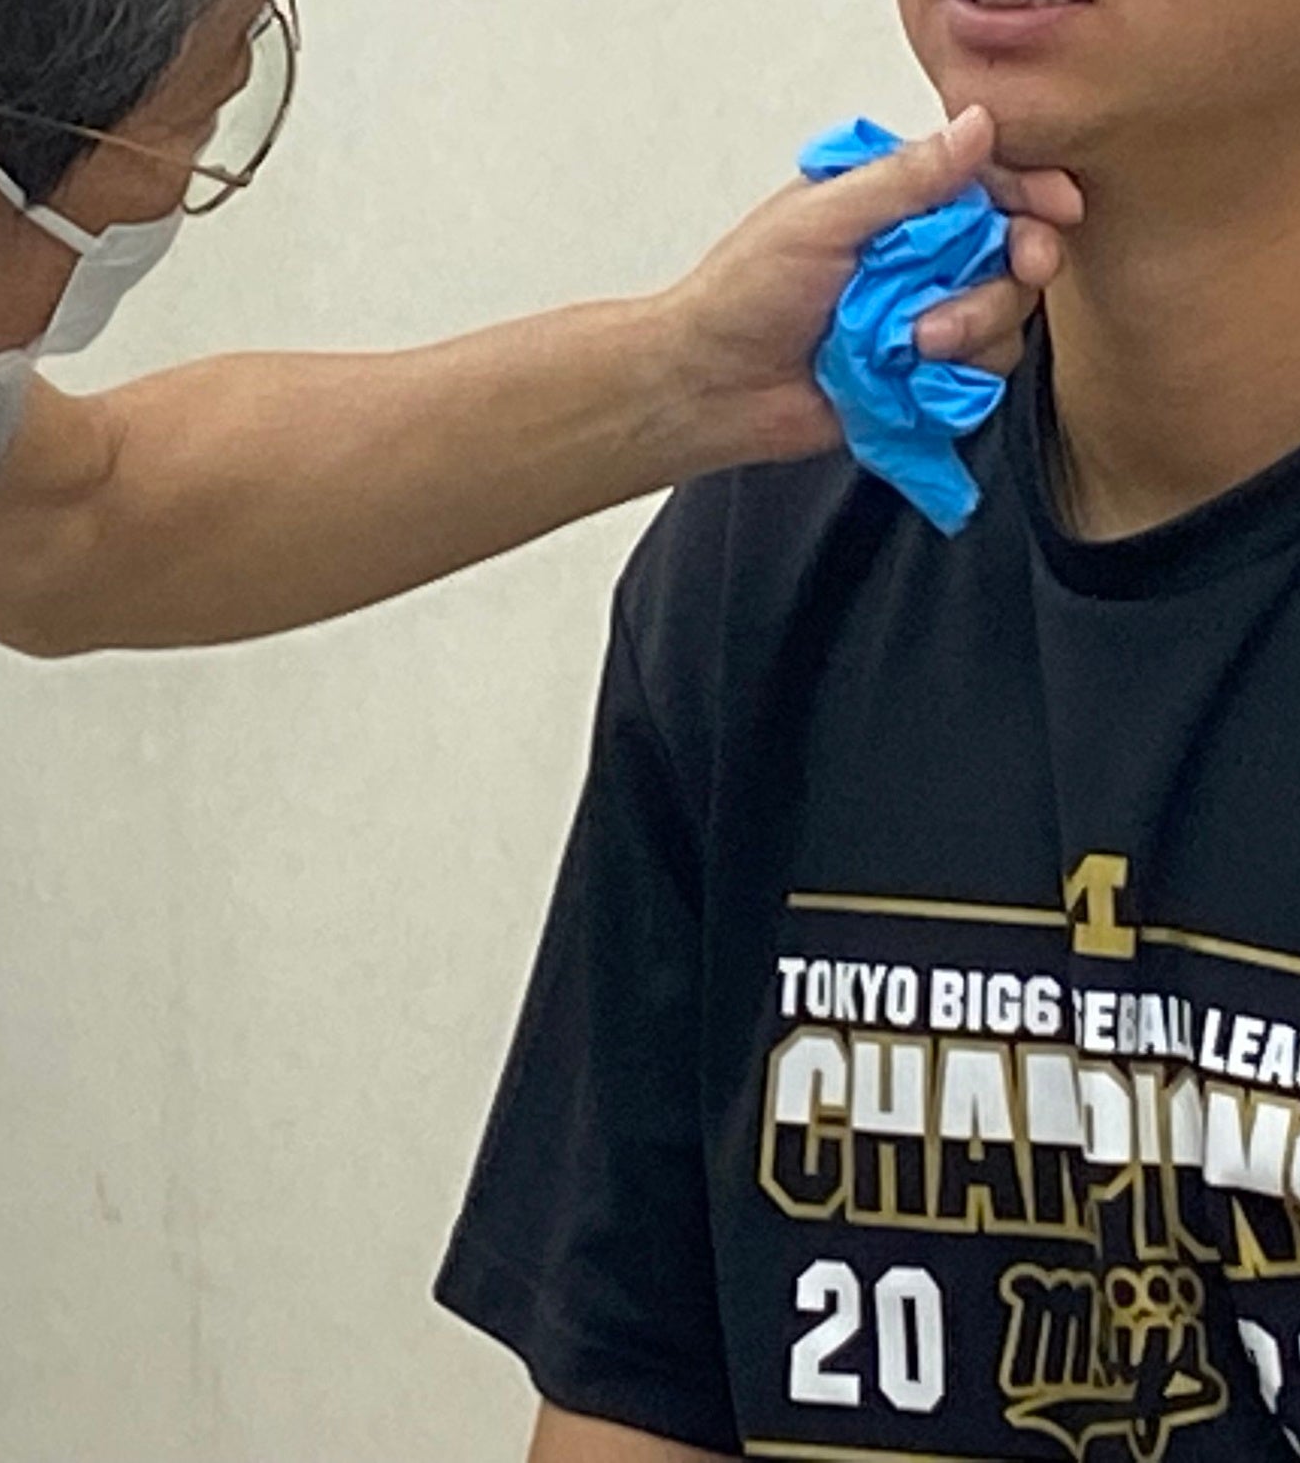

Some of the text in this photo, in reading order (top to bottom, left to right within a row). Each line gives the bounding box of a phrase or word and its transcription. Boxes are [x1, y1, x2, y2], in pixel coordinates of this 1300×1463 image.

[777, 956, 919, 1027] TOKYO
[929, 968, 1062, 1037] BIG6
[789, 1258, 945, 1414] 20
